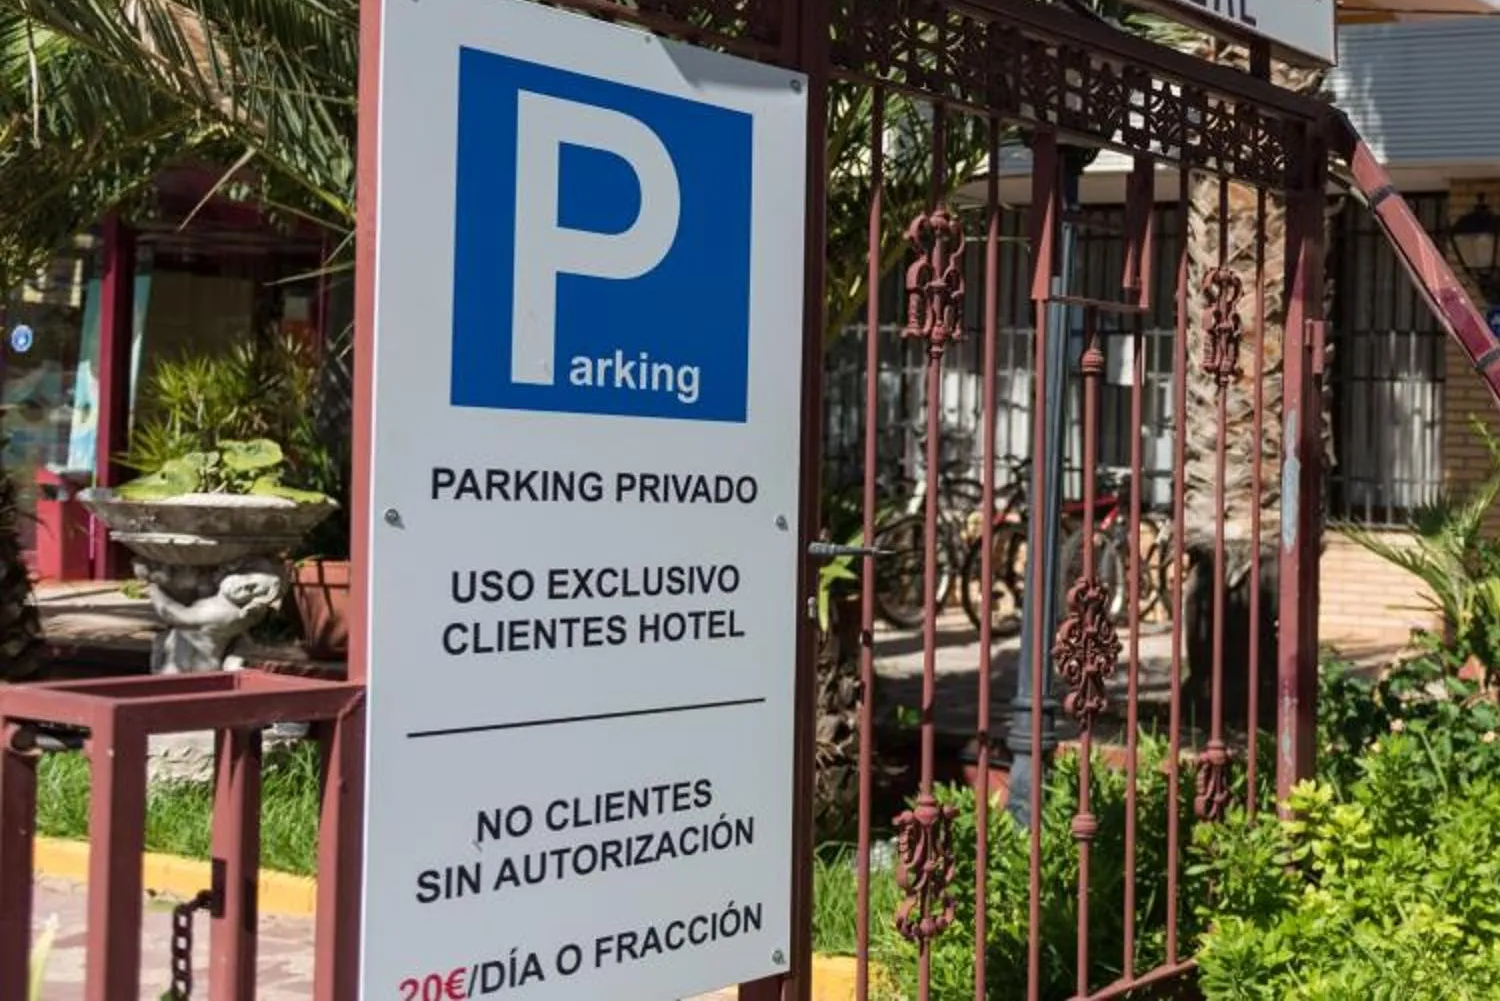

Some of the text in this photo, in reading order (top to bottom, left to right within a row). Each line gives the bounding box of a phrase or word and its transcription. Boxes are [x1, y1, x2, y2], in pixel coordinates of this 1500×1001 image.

[432, 467, 758, 504] PARKING PRIVADO
[451, 564, 740, 603] USO EXCLUSIVO
[443, 610, 745, 656] CLIENTES HOTEL
[477, 779, 713, 843] NO CLIENTES
[416, 814, 755, 903] SIN AUTORIZACIÓN
[399, 901, 763, 1001] 20€/DÍA O FRACCIÓN
